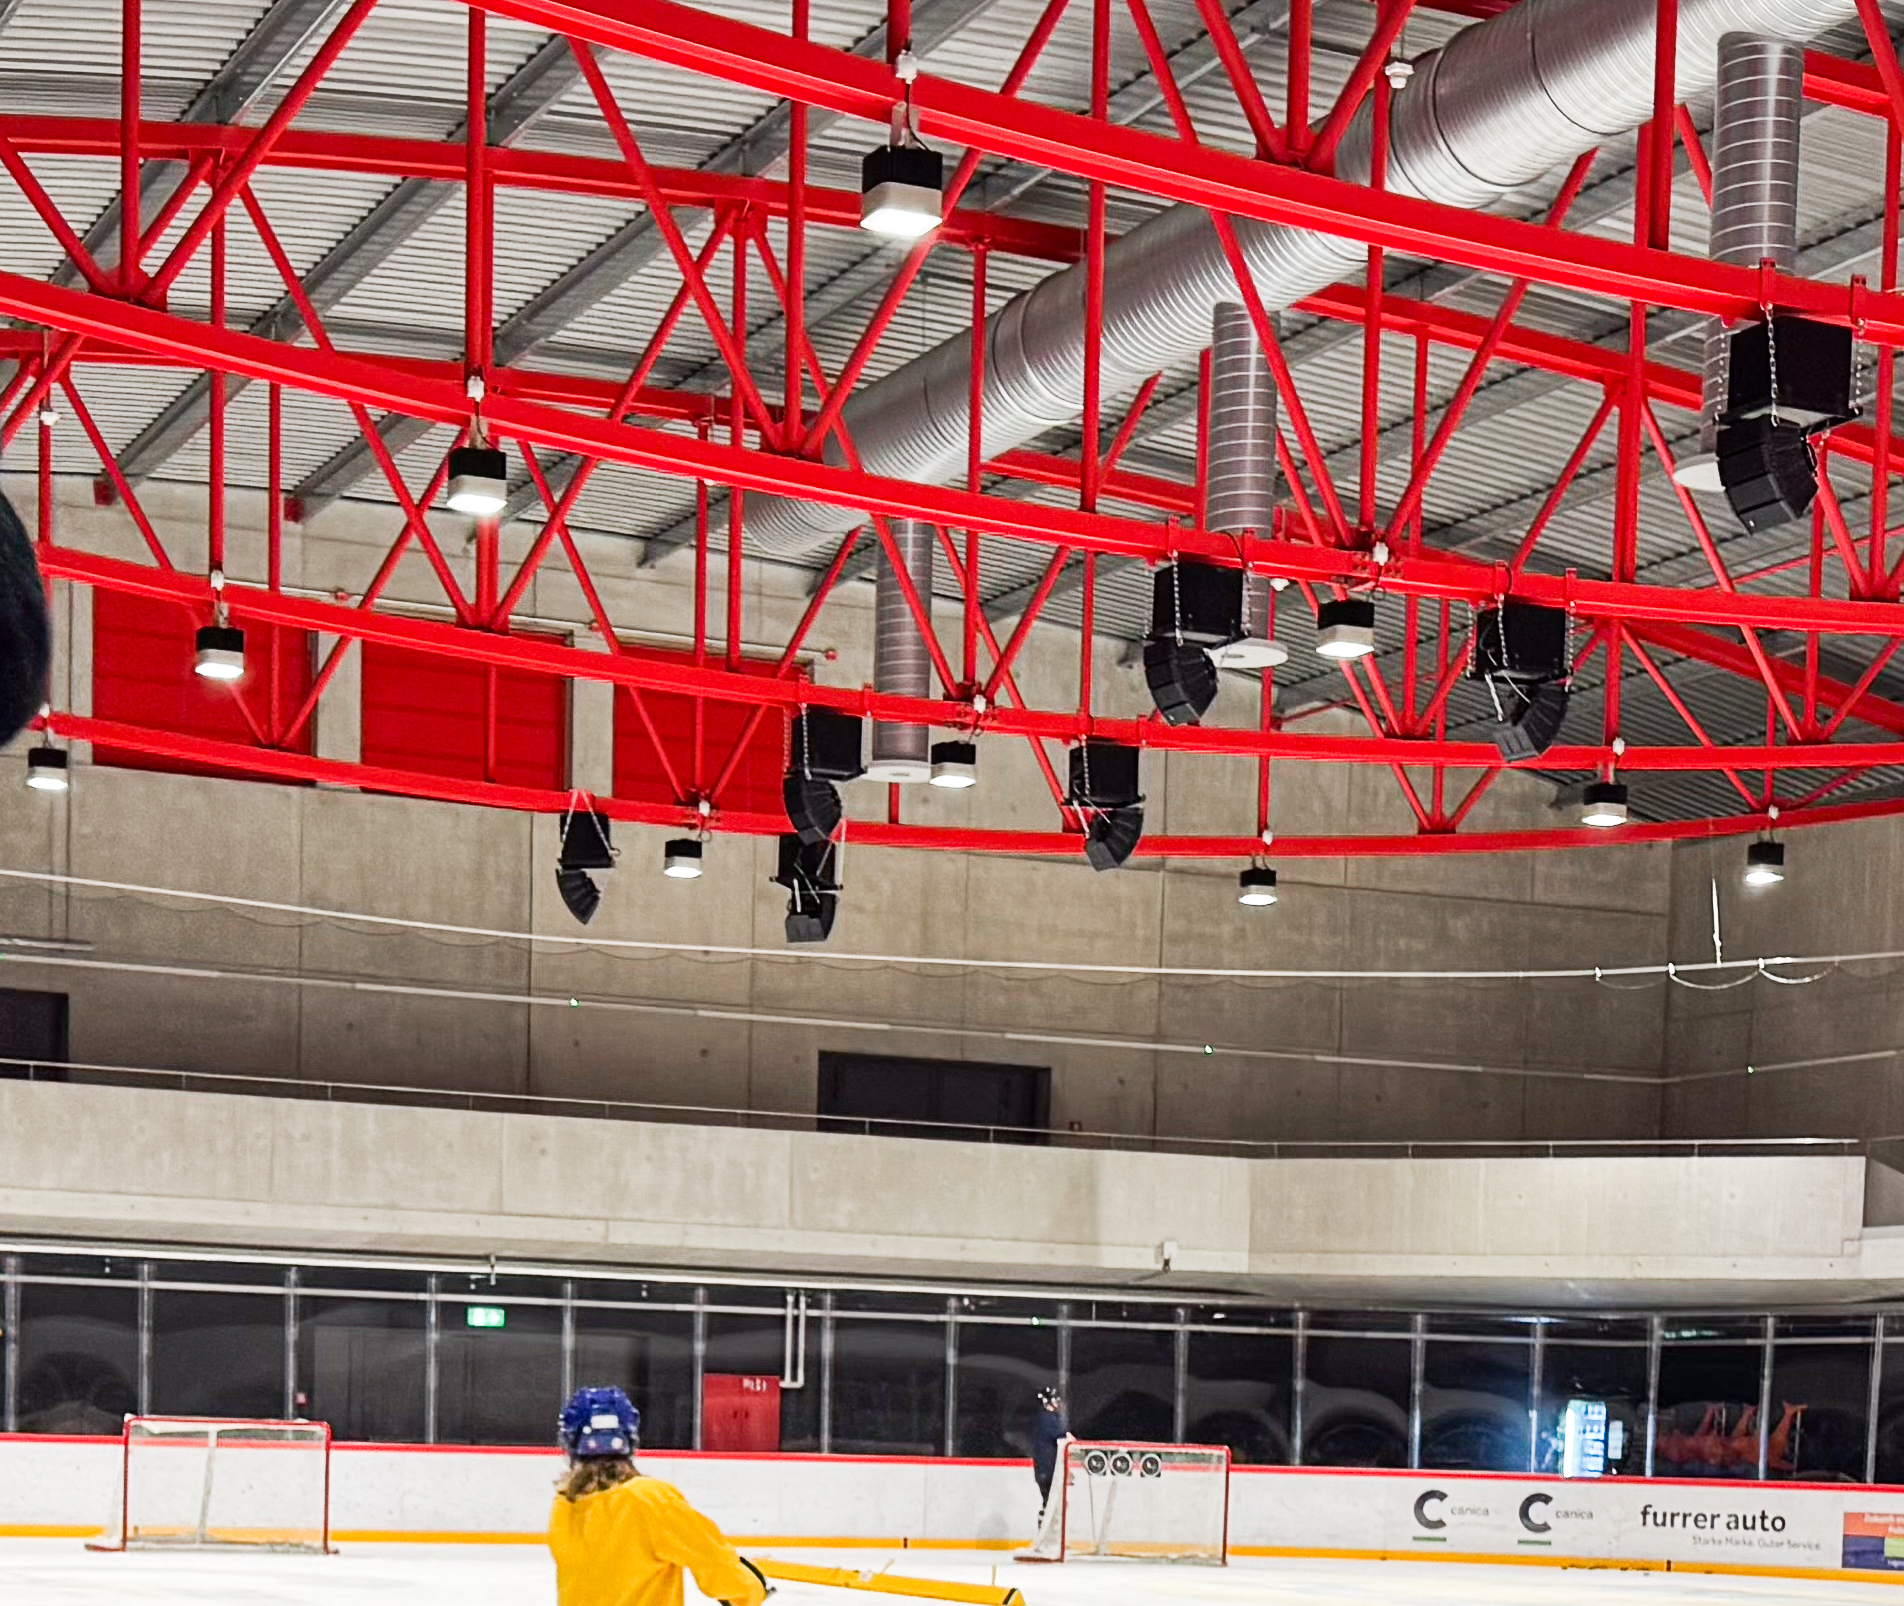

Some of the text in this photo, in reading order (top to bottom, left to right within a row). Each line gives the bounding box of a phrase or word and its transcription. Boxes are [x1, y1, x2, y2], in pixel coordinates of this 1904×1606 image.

[1451, 1505, 1489, 1517] canica
[1556, 1508, 1594, 1520] canica
[1640, 1504, 1786, 1532] furrer auto
